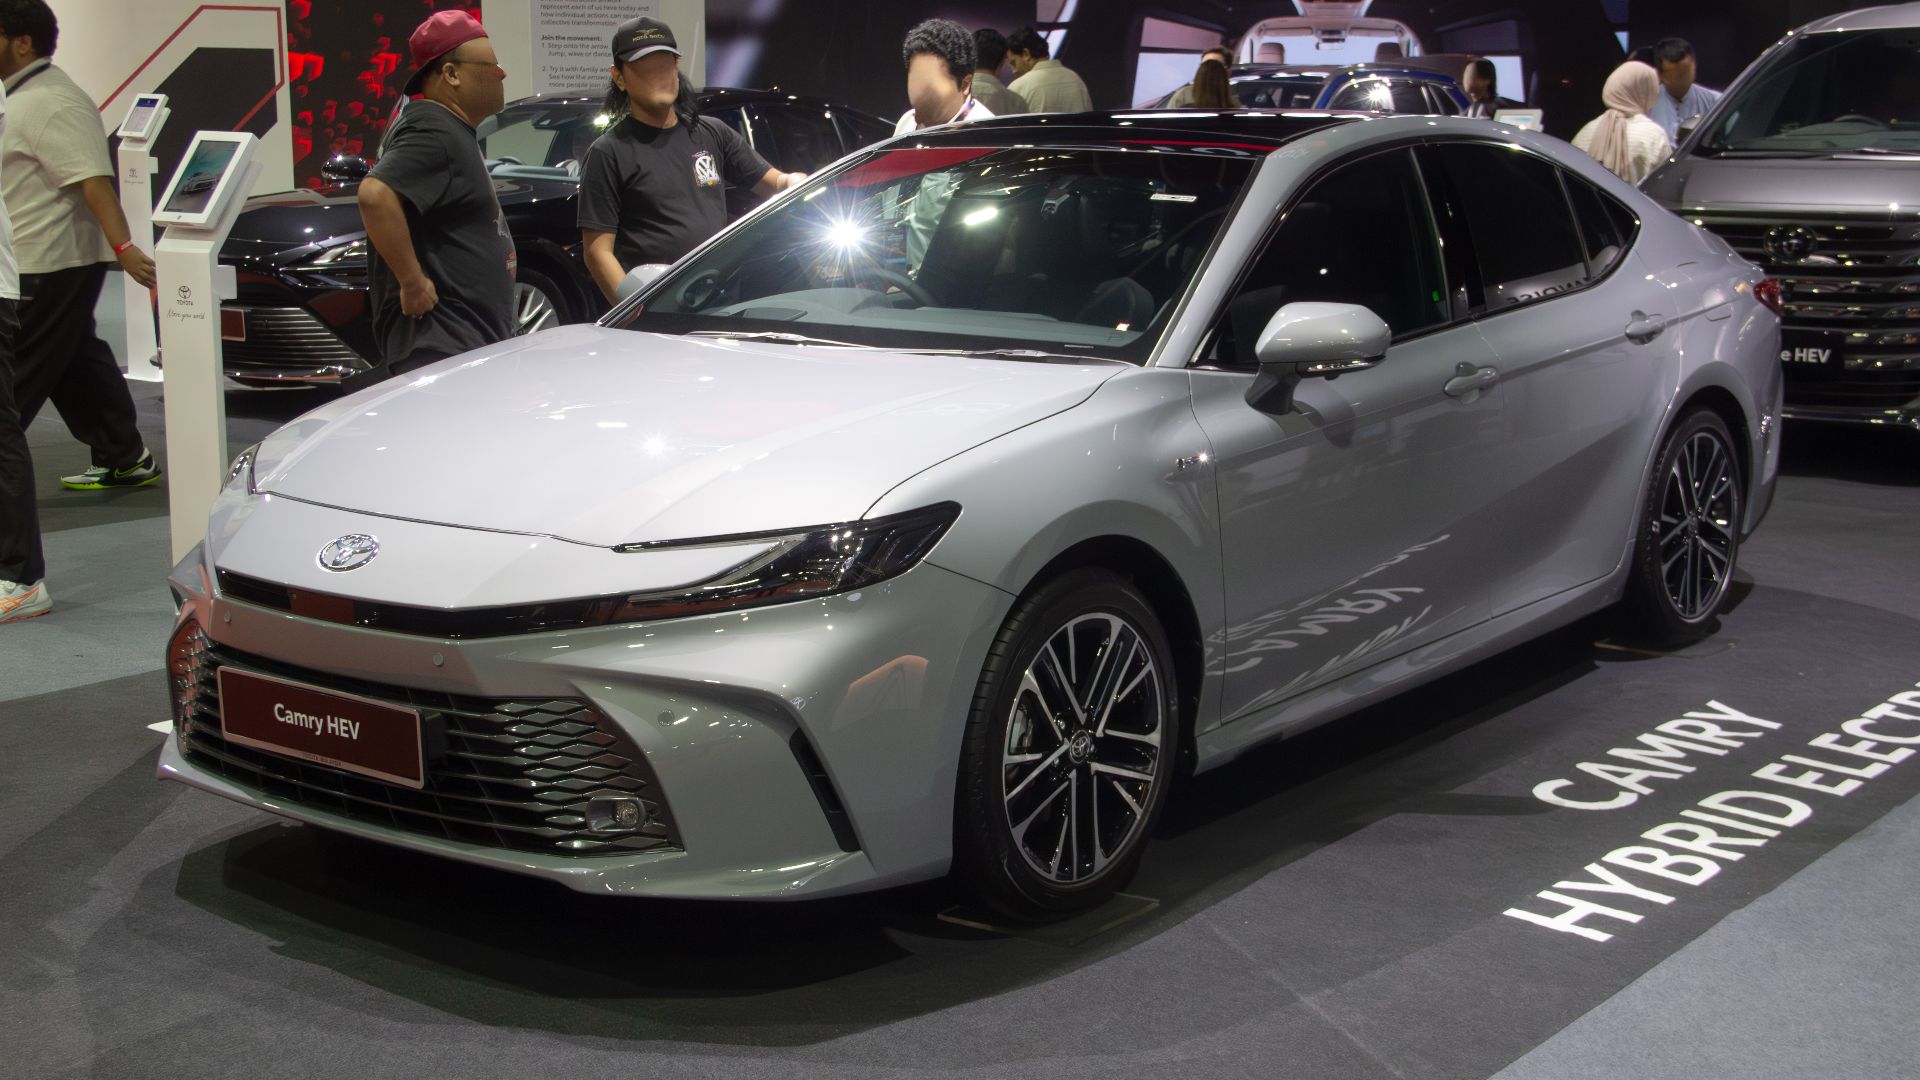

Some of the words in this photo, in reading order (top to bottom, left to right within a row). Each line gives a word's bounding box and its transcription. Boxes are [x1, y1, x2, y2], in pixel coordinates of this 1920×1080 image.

[618, 5, 636, 13] today
[550, 66, 558, 74] Try
[580, 66, 598, 74] family
[566, 82, 588, 90] people
[1794, 347, 1832, 364] HEV
[274, 703, 323, 736] Camry
[327, 715, 360, 740] HEV
[1531, 699, 1784, 811] CAMRY
[1502, 789, 1813, 943] HYBRID
[1751, 680, 1920, 797] ELECT
